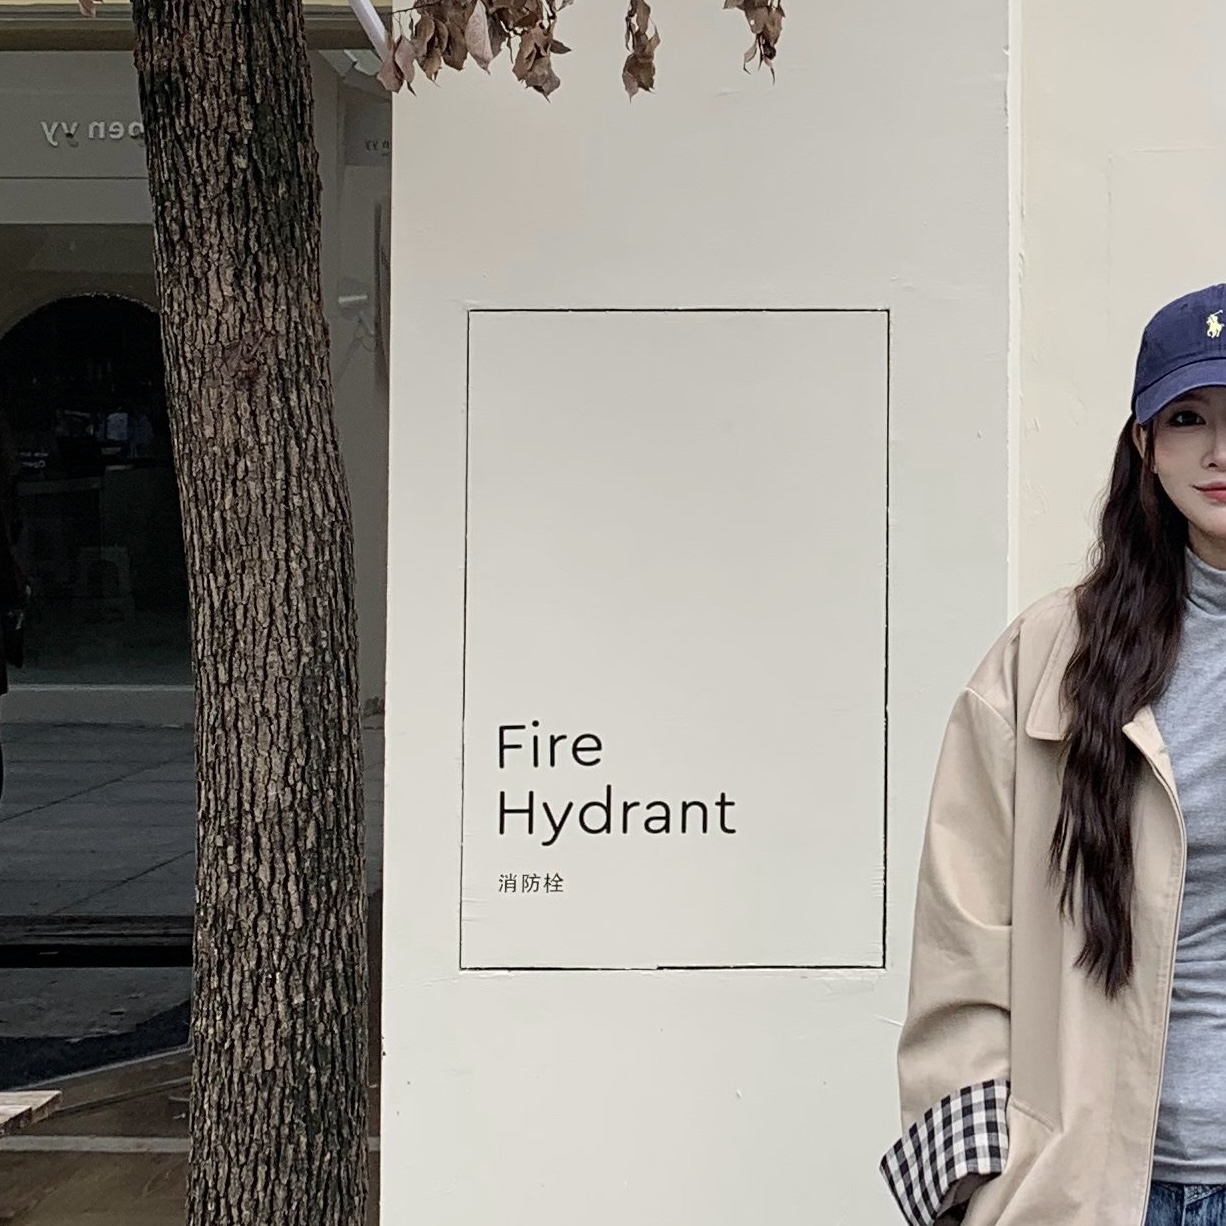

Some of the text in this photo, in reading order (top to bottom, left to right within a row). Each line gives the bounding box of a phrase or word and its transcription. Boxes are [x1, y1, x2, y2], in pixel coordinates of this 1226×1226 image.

[498, 720, 603, 769] Fire
[498, 784, 736, 846] Hydrant
[498, 873, 564, 893] 消防栓
